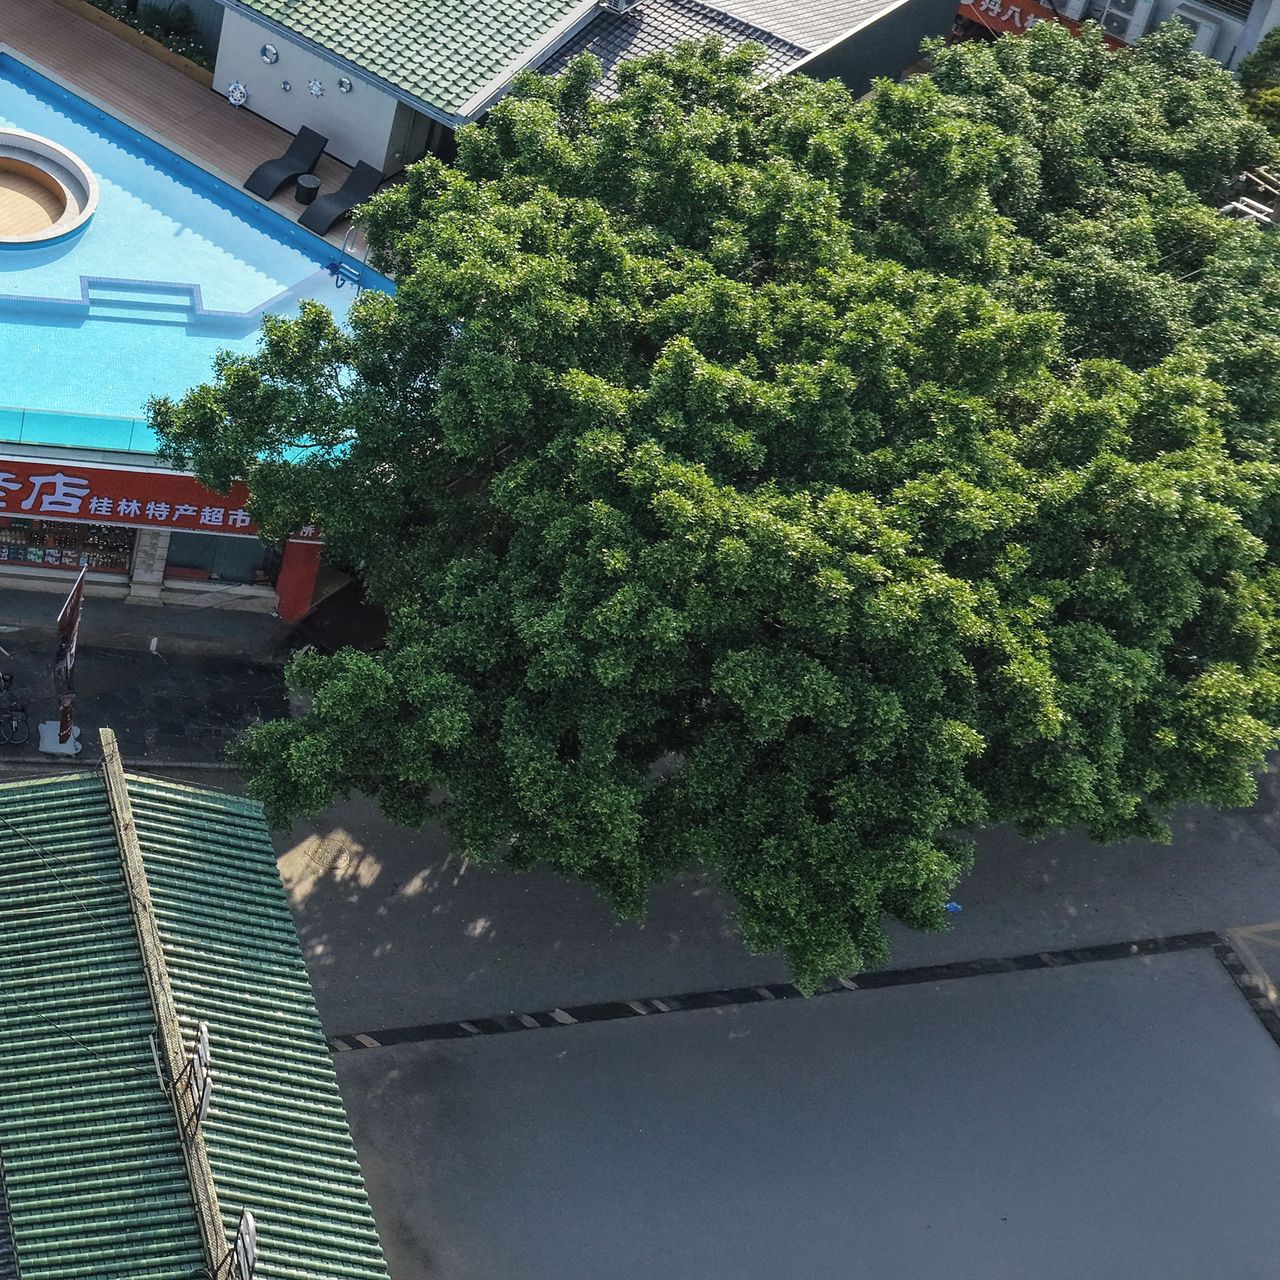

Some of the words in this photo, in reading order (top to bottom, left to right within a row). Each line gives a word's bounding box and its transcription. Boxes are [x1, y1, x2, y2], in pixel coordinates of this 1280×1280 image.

[88, 496, 252, 528] 桂林特产超市
